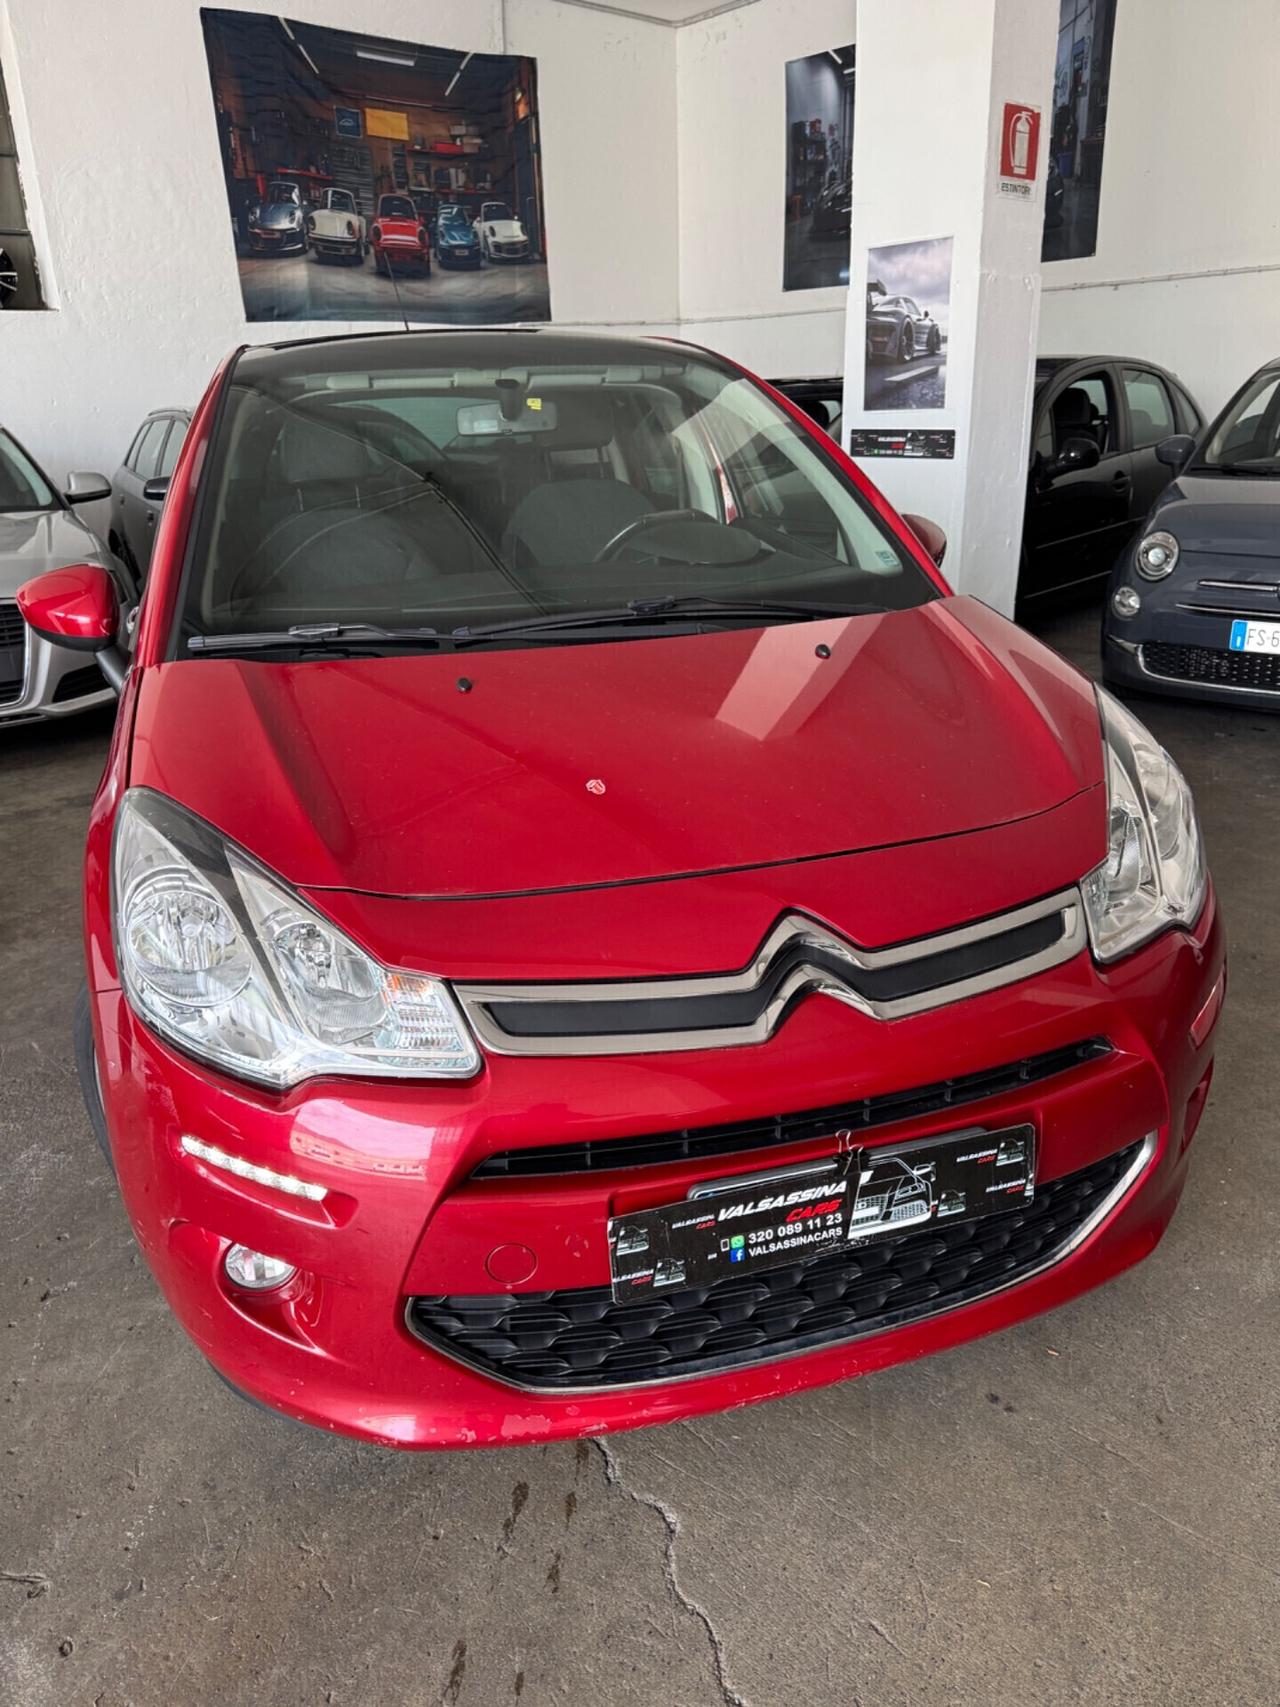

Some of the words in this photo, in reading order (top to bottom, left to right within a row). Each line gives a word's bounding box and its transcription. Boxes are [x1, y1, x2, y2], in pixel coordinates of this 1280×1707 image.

[1247, 628, 1266, 647] FS
[717, 1180, 848, 1222] VALSASSINA
[785, 1198, 843, 1223] CARS
[748, 1229, 774, 1244] 320
[777, 1222, 803, 1237] 089
[807, 1218, 821, 1230] 11
[826, 1212, 843, 1226] 23
[748, 1226, 844, 1258] VALSASSINACARS
